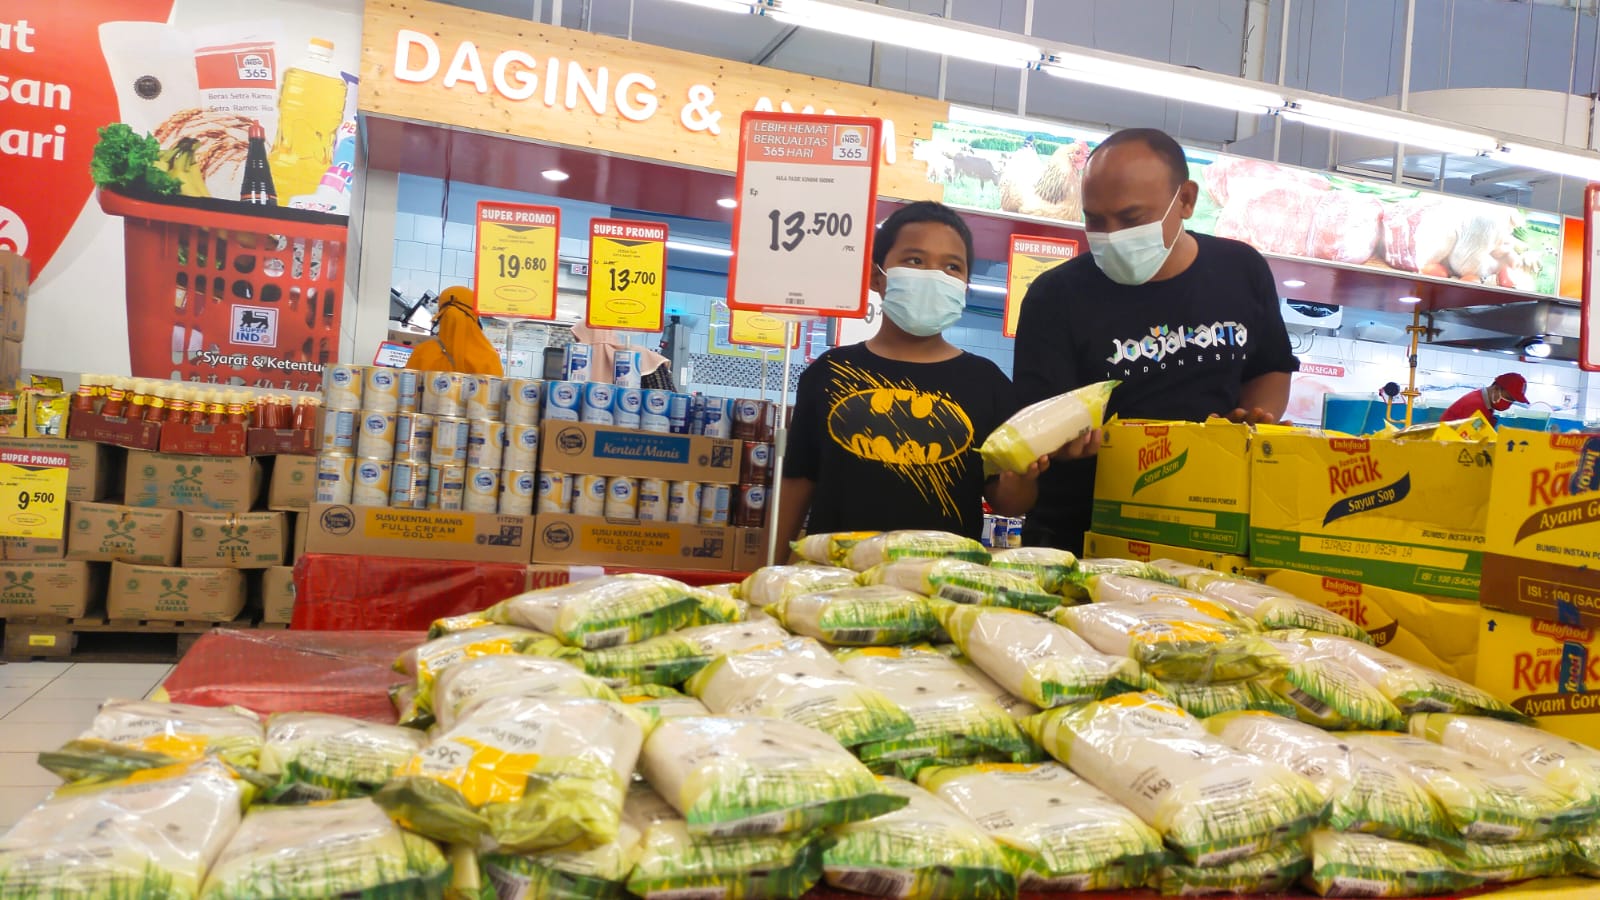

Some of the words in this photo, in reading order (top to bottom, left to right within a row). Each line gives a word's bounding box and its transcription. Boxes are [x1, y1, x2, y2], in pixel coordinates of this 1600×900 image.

[245, 69, 267, 78] 365
[394, 29, 659, 122] DAGING
[681, 84, 722, 136] &
[754, 121, 786, 133] LEBIH
[788, 123, 830, 135] HEMAT
[753, 134, 828, 147] BERKUALITAS
[763, 146, 785, 157] 365
[785, 148, 814, 158] HARI
[839, 147, 862, 159] 365
[481, 208, 513, 222] SUPER
[515, 209, 556, 225] PROMO!
[593, 223, 624, 236] SUPER
[626, 226, 664, 240] PROMO!
[768, 209, 853, 252] 13.500
[1014, 241, 1040, 254] SUPER
[1041, 244, 1074, 257] PROMO!
[498, 253, 547, 278] 19.680
[609, 268, 656, 292] 13.700
[236, 332, 271, 344] INDO
[252, 356, 264, 368] &
[1106, 353, 1247, 378] INDONESIA
[1315, 366, 1338, 376] SEGAR
[603, 442, 642, 456] Kental
[643, 445, 680, 459] Manis
[1138, 437, 1172, 471] Racik
[1, 452, 30, 463] SUPER
[31, 453, 67, 466] PROMO!
[1328, 455, 1383, 495] Racik
[17, 490, 55, 510] 9.500
[1348, 494, 1376, 512] Sayur
[1377, 488, 1396, 502] Sop
[375, 513, 398, 522] SUSU
[400, 515, 433, 525] KENTAL
[434, 518, 463, 526] MANIS
[1540, 506, 1583, 530] Ayam
[381, 523, 411, 532] FULL
[414, 525, 456, 534] CREAM
[402, 531, 434, 539] GOLD
[613, 530, 642, 538] KENTAL
[644, 531, 671, 540] MANIS
[596, 537, 624, 546] FULL
[626, 539, 664, 547] CREAM
[1536, 543, 1562, 554] BUMBU
[1563, 547, 1591, 559] INSTAN
[1527, 585, 1542, 598] ISI
[1551, 589, 1570, 603] 100
[1536, 620, 1589, 639] Indofood
[1524, 697, 1566, 716] Ayam
